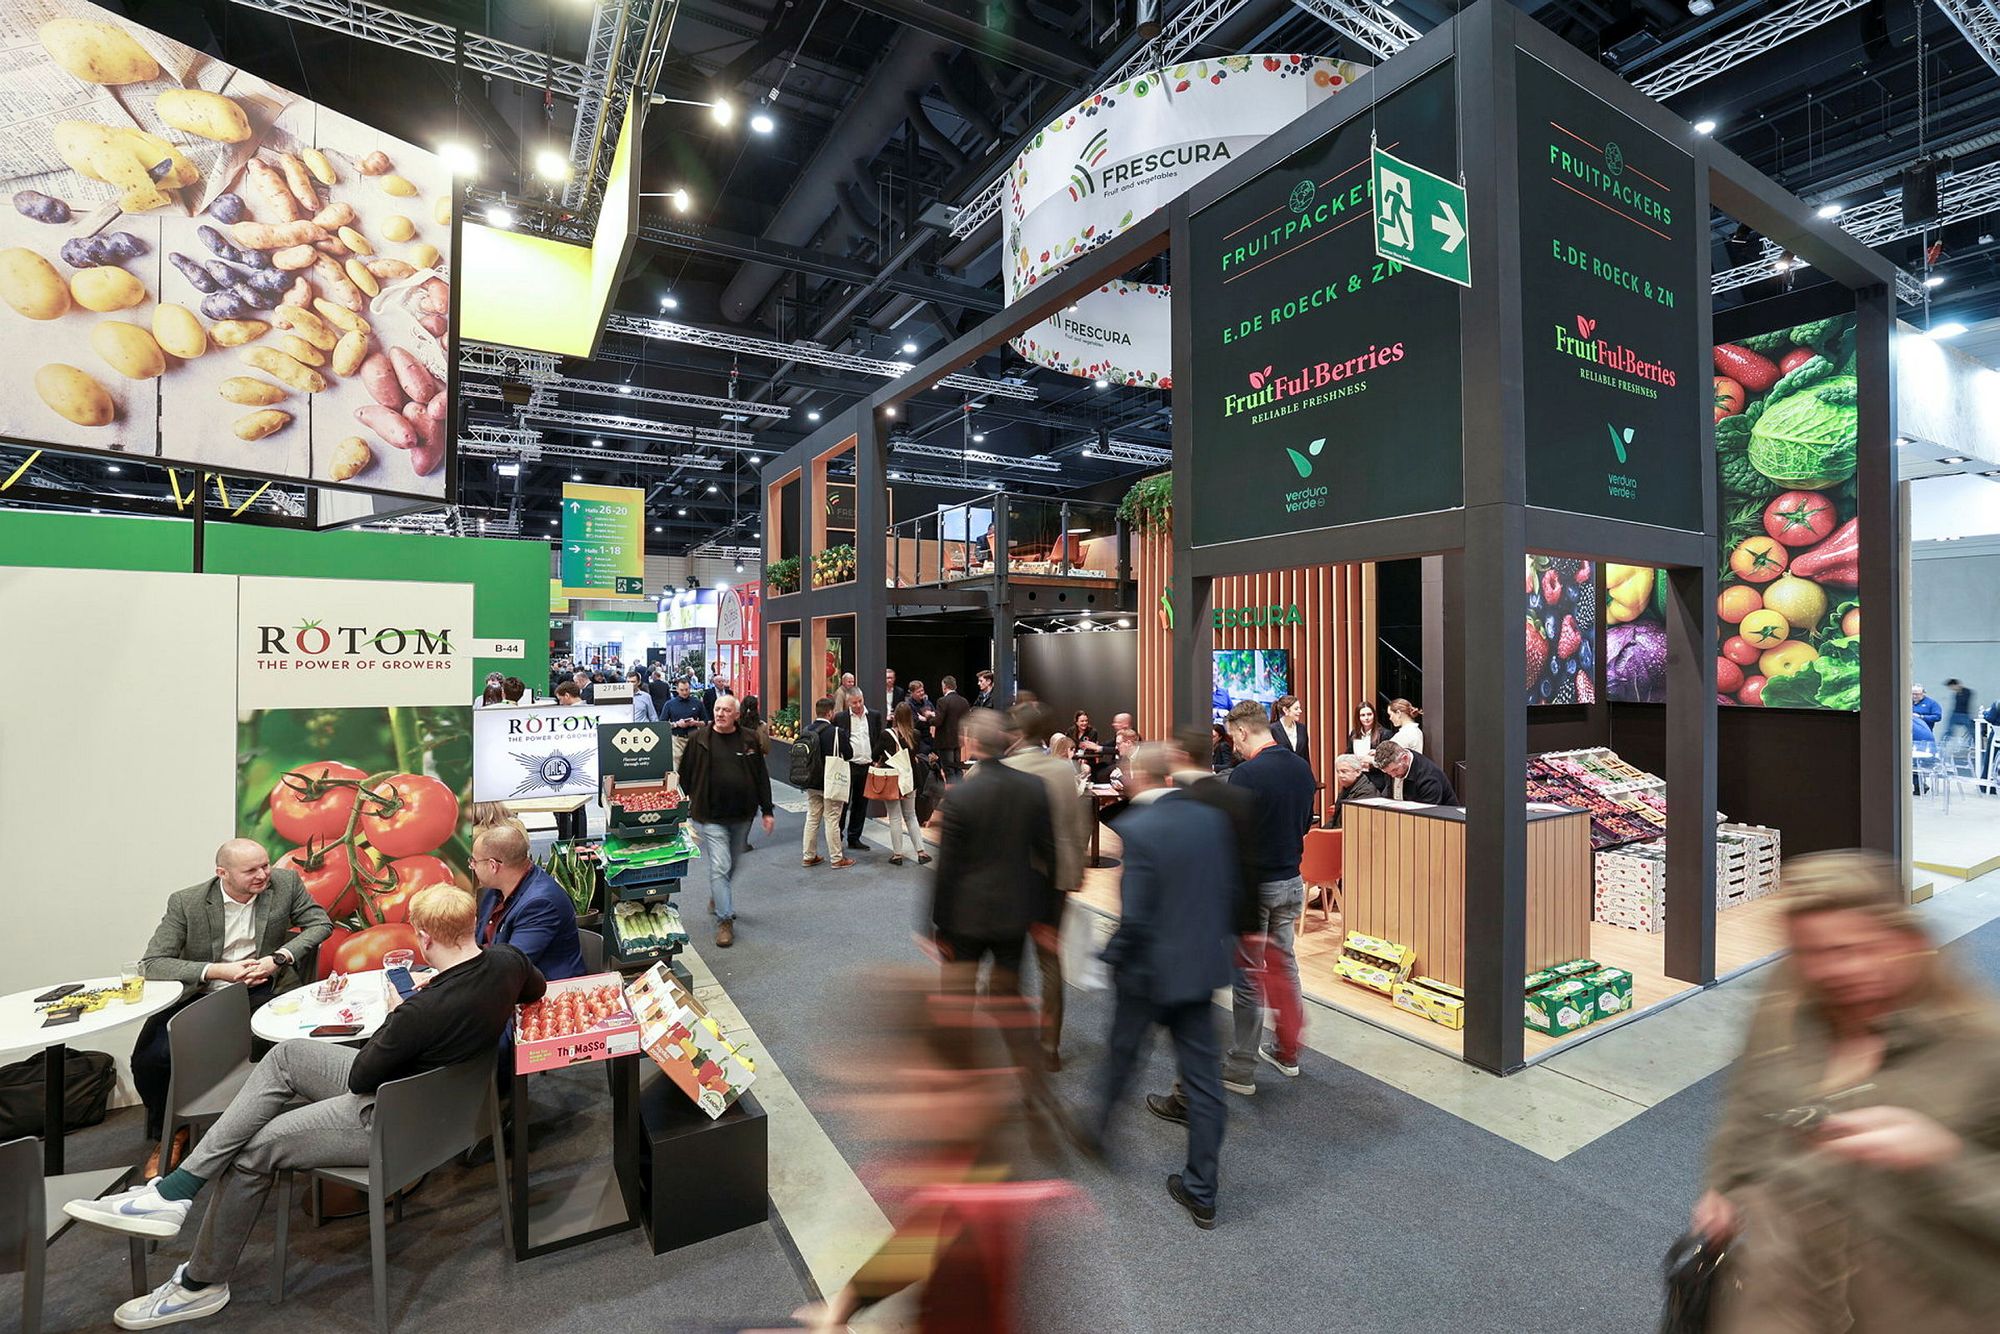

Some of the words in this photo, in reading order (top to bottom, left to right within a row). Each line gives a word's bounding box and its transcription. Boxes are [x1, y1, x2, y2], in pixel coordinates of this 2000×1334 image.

[1102, 141, 1231, 188] FRESCURA
[1103, 187, 1119, 198] Fruit
[1121, 182, 1135, 192] and
[1137, 171, 1178, 185] vegetables
[1550, 144, 1672, 226] FRUITPACKERS
[1221, 178, 1374, 271] FRUITPACKE
[1552, 239, 1587, 271] E.DE
[1593, 255, 1639, 293] ROECK
[1644, 281, 1653, 299] &
[1657, 286, 1675, 309] ZN
[1222, 313, 1262, 345] E.DE
[1271, 284, 1338, 325] ROECK
[1347, 274, 1362, 293] &
[1064, 319, 1131, 346] FRESCURA
[1580, 368, 1616, 388] RELIABLE
[1618, 379, 1658, 399] FRESHNESS
[1251, 402, 1300, 425] RELIABLE
[1302, 381, 1367, 409] FRESHNESS
[1608, 473, 1637, 488] verdura
[1608, 485, 1629, 498] verde
[1285, 486, 1328, 502] verdura
[1285, 499, 1316, 513] verde
[599, 505, 628, 515] 26-20
[599, 546, 621, 555] 1-18
[1212, 604, 1303, 628] ESCURA
[257, 624, 454, 655] ROTOM
[495, 644, 518, 653] B-44
[257, 660, 288, 670] THE
[295, 660, 350, 670] POWER
[357, 660, 375, 670] OF
[382, 660, 452, 670] GROWERS
[508, 715, 600, 734] ROTOM
[620, 736, 651, 745] REO
